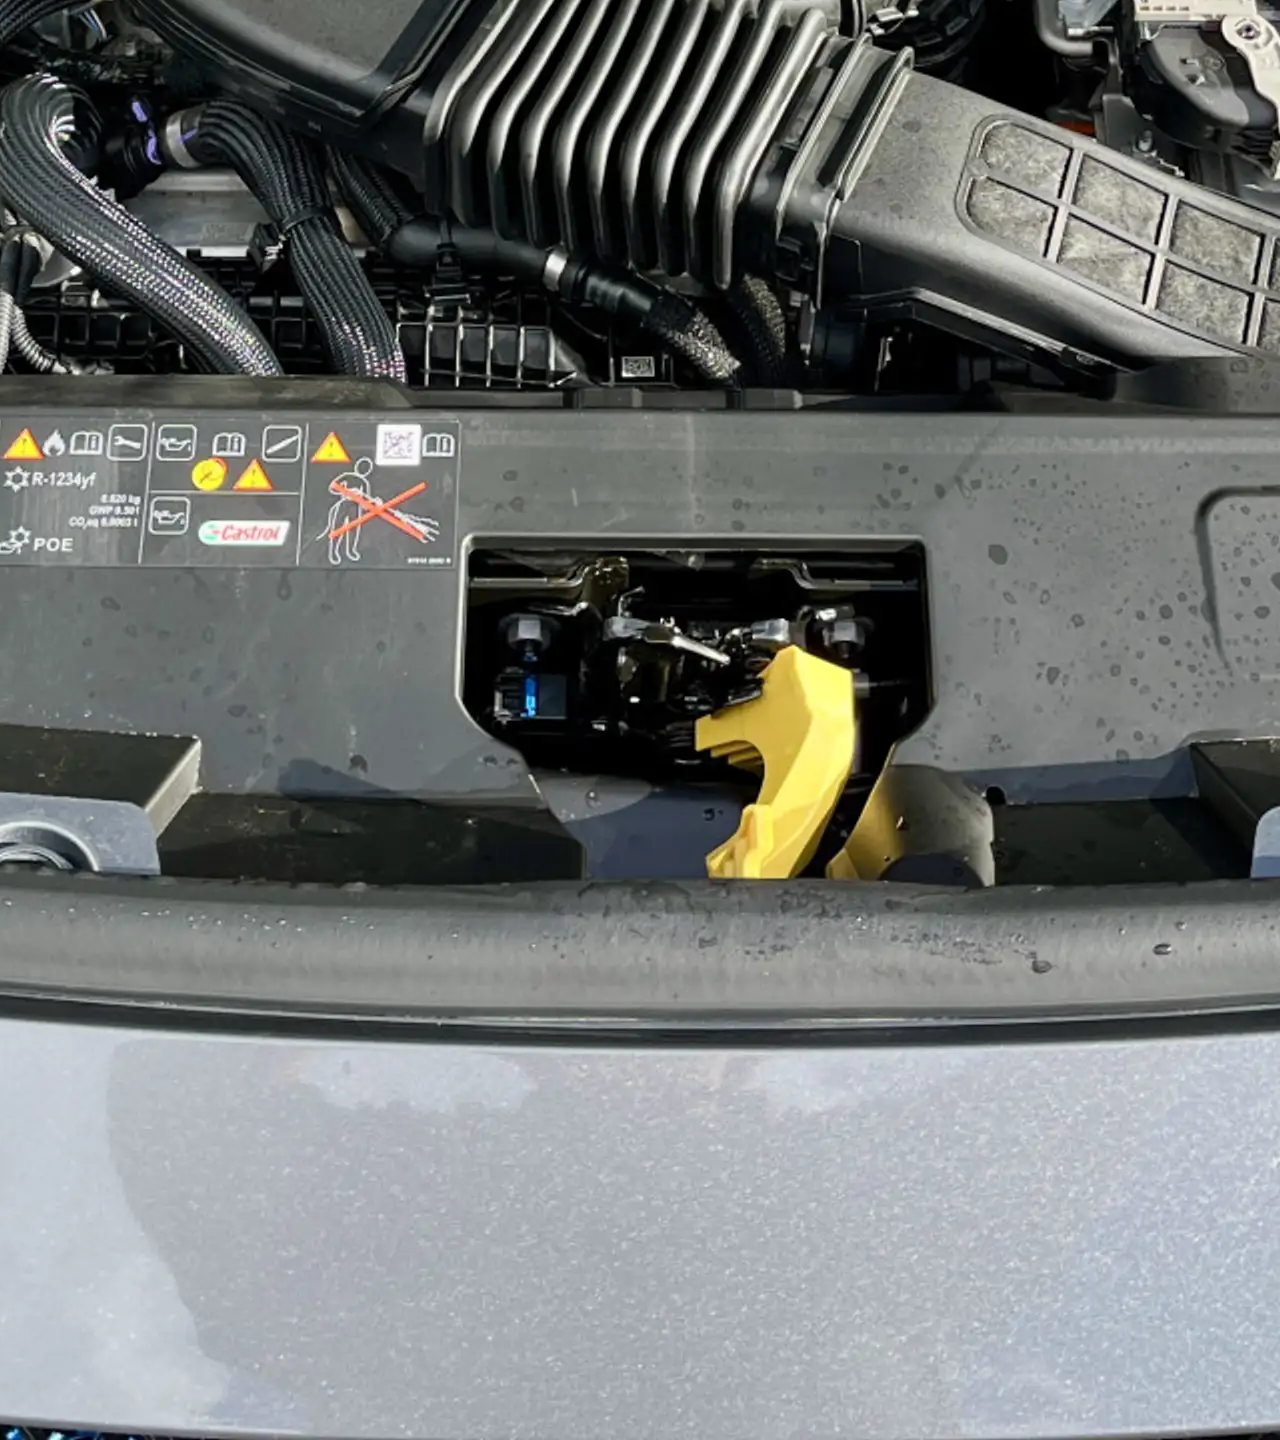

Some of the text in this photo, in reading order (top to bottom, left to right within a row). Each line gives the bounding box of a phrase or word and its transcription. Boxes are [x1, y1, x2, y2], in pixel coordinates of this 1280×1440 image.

[31, 471, 97, 490] R-1234yf
[220, 523, 282, 542] Castrol
[32, 537, 74, 552] POE
